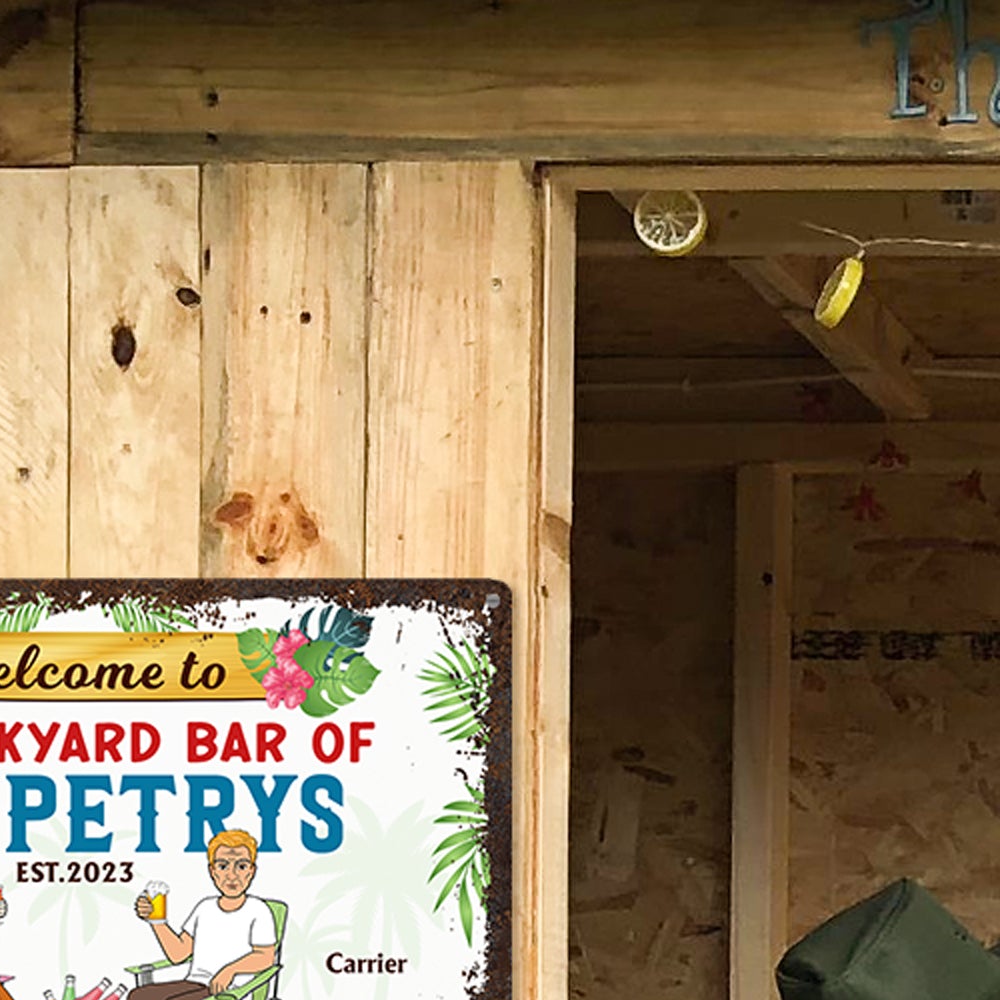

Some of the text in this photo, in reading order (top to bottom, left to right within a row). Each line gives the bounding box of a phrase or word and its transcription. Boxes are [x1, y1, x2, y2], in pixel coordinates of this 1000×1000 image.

[860, 0, 1000, 126] Th
[180, 643, 227, 691] to
[187, 721, 287, 763] BAR
[312, 721, 375, 764] OF
[5, 773, 344, 854] PETRYS
[16, 861, 134, 883] EST.2023
[326, 952, 408, 975] Carrier
